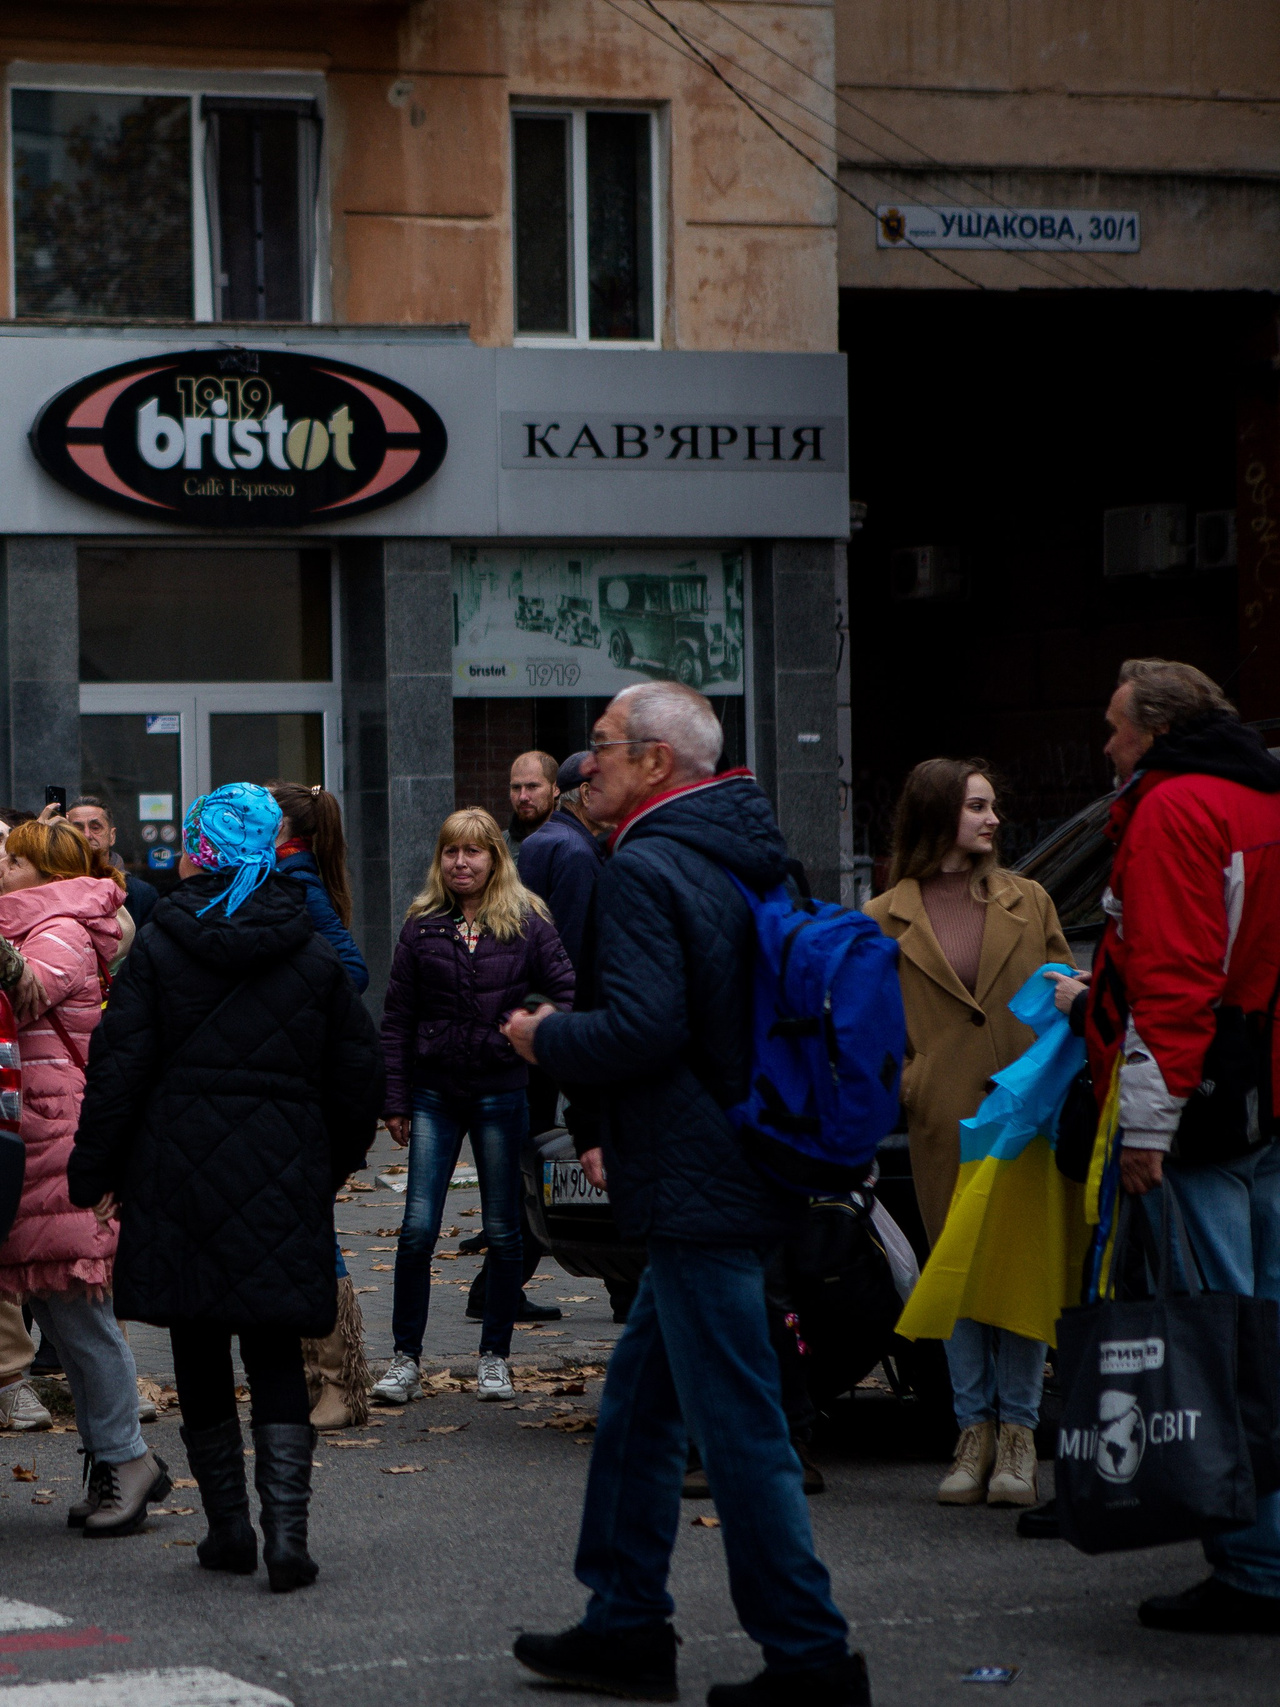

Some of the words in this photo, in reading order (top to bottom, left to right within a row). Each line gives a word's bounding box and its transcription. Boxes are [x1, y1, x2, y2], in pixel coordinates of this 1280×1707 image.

[940, 213, 1083, 244] УШАКОВА,
[1089, 215, 1136, 241] 30/1
[176, 376, 272, 422] 1919
[136, 396, 357, 471] bristot
[230, 478, 295, 501] Espresso
[469, 664, 507, 677] bristot
[526, 663, 581, 686] 1919
[1149, 1409, 1202, 1444] СВІТ
